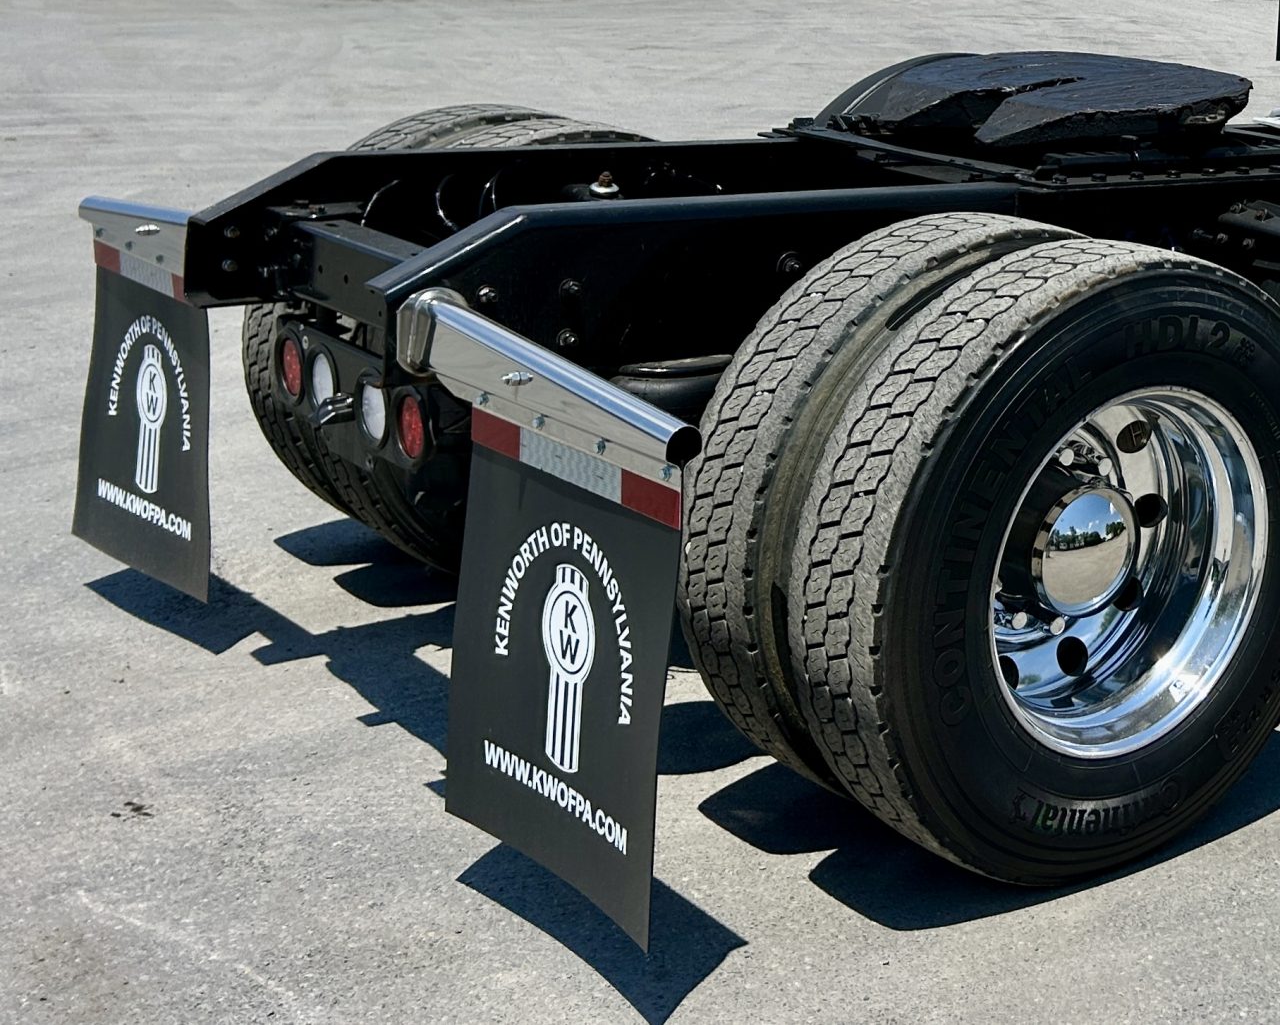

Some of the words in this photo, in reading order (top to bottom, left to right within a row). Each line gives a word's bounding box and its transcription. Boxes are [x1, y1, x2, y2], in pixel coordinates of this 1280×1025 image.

[108, 323, 142, 417] KENWORTH
[140, 314, 152, 335] OF
[151, 318, 192, 453] PENNSYLVANIA
[98, 477, 192, 542] WWW.KWOFPA.COM
[934, 354, 1095, 730] CONTINENTAL
[495, 528, 550, 657] KENWORTH
[550, 521, 571, 550] OF
[573, 525, 634, 726] PENNSYLVANIA
[484, 739, 628, 857] WWW.KWOFPA.COM
